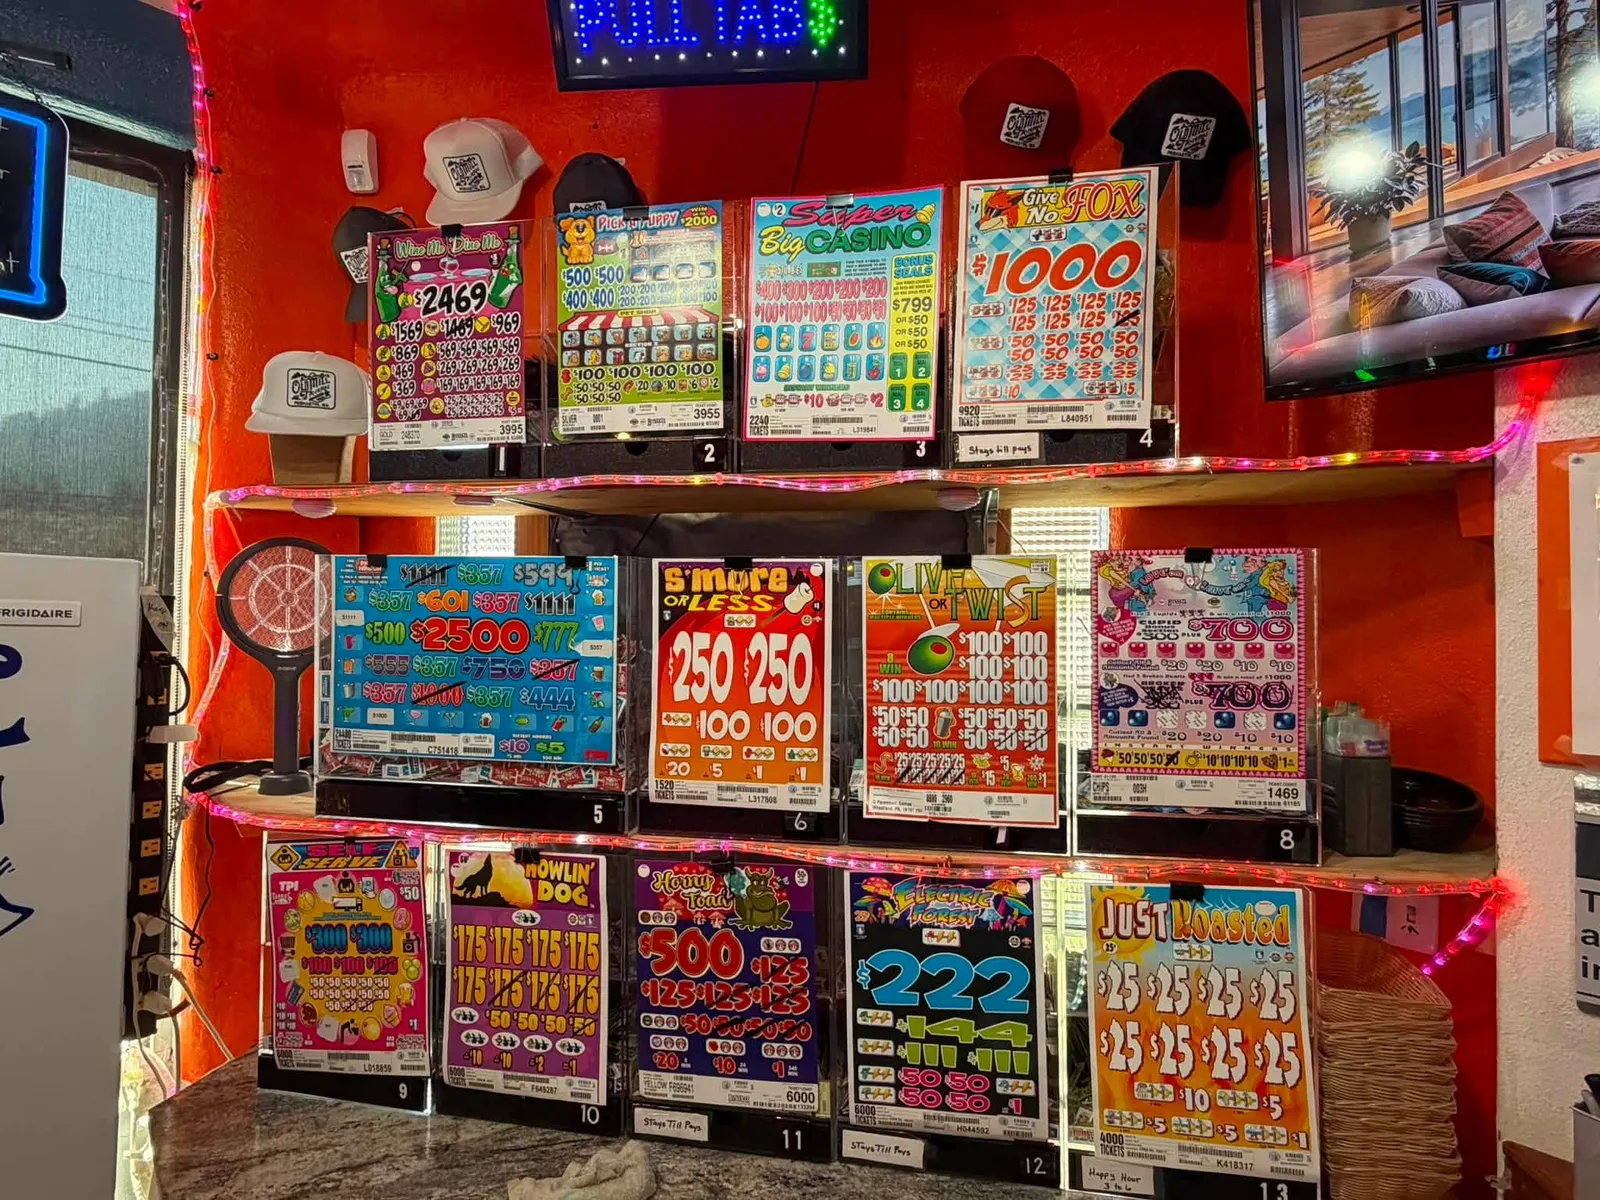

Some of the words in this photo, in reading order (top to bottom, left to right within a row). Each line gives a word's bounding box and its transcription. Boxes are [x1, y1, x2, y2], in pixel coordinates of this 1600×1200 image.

[1023, 188, 1059, 206] Give
[1061, 180, 1147, 222] FOX
[598, 215, 625, 230] PICK
[681, 216, 718, 227] $2000
[782, 201, 918, 230] Super
[1025, 205, 1059, 224] No
[394, 238, 426, 260] Wine
[449, 235, 481, 254] Dine
[759, 226, 808, 263] Big
[805, 222, 932, 254] CASINO
[894, 256, 933, 267] BONUS
[971, 239, 1143, 296] $1000
[562, 268, 592, 287] $500
[595, 265, 625, 285] $500
[894, 268, 933, 279] SEALS
[414, 281, 488, 317] $2469
[563, 289, 587, 310] $400
[590, 288, 615, 308] $400
[892, 296, 932, 313] $799
[1009, 296, 1037, 314] $125
[391, 320, 423, 342] $1569
[491, 314, 521, 334] $969
[908, 315, 928, 326] $50
[391, 345, 418, 362] $869
[437, 340, 457, 358] $569
[573, 367, 606, 381] $100
[694, 408, 720, 419] 3955
[750, 415, 769, 426] 2240
[959, 405, 980, 415] 9920
[1061, 415, 1093, 423] L840951
[500, 424, 523, 435] 3995
[1139, 428, 1153, 447] 4
[704, 444, 715, 462] 2
[916, 441, 926, 457] 3
[457, 563, 505, 585] $357
[868, 562, 965, 595] OLIVE
[368, 590, 413, 611] $357
[417, 589, 470, 612] $601
[663, 595, 689, 607] OR
[688, 594, 775, 611] LESS
[929, 599, 947, 609] OR
[949, 575, 1047, 628] TWIST
[364, 621, 406, 645] $500
[409, 615, 531, 654] $2500
[533, 621, 580, 653] $777
[1188, 617, 1294, 641] $700
[959, 631, 1002, 656] $100
[1003, 631, 1048, 656] $100
[461, 655, 527, 680] $750
[668, 631, 734, 704] $250
[744, 632, 813, 706] $250
[879, 663, 902, 674] WIN
[1161, 659, 1188, 671] $20
[1196, 660, 1224, 672] $20
[1233, 660, 1258, 672] $10
[519, 686, 576, 712] $444
[696, 709, 750, 740] $100
[759, 711, 817, 742] $100
[872, 706, 900, 728] $50
[499, 739, 530, 754] $10
[535, 742, 566, 755] $5
[666, 761, 690, 776] $20
[655, 780, 674, 790] 1520
[655, 790, 674, 800] TICKETS
[1267, 787, 1299, 799] 1469
[593, 804, 603, 824] 5
[794, 812, 807, 830] 6
[1280, 829, 1295, 850] 8
[299, 856, 383, 869] SERVE
[525, 859, 596, 885] HOWLIN'
[279, 881, 299, 892] TPI
[400, 887, 419, 900] $50
[652, 870, 713, 894] Horny
[537, 880, 589, 907] DOG
[683, 888, 733, 910] Toad
[892, 877, 994, 913] ELECTRIC
[912, 904, 980, 927] FOREST
[1098, 897, 1169, 942] JUST
[1171, 898, 1291, 946] Roasted
[305, 923, 348, 954] $300
[452, 924, 487, 963] $175
[490, 927, 524, 965] $175
[638, 927, 744, 980] $500
[302, 956, 332, 975] $100
[856, 949, 1031, 1014] $222
[1098, 959, 1142, 1014] $25
[1147, 962, 1192, 1017] $25
[641, 978, 696, 1008] $125
[896, 1015, 1033, 1048] $144
[897, 1042, 958, 1068] $111
[399, 1083, 408, 1099] 9
[786, 1091, 815, 1103] 6000
[855, 1105, 876, 1116] 6000
[1179, 1087, 1211, 1113] $10
[1263, 1095, 1283, 1121] $5
[580, 1105, 600, 1125] 10
[855, 1115, 877, 1126] TICKETS
[957, 1125, 990, 1135] H044592
[783, 1129, 801, 1150] 11
[1100, 1132, 1124, 1145] 4000
[1025, 1157, 1046, 1175] 12
[1100, 1143, 1125, 1158] TICKETS
[1217, 1159, 1254, 1170] K418317
[1089, 1168, 1116, 1183] Happy
[1120, 1172, 1142, 1183] Hour
